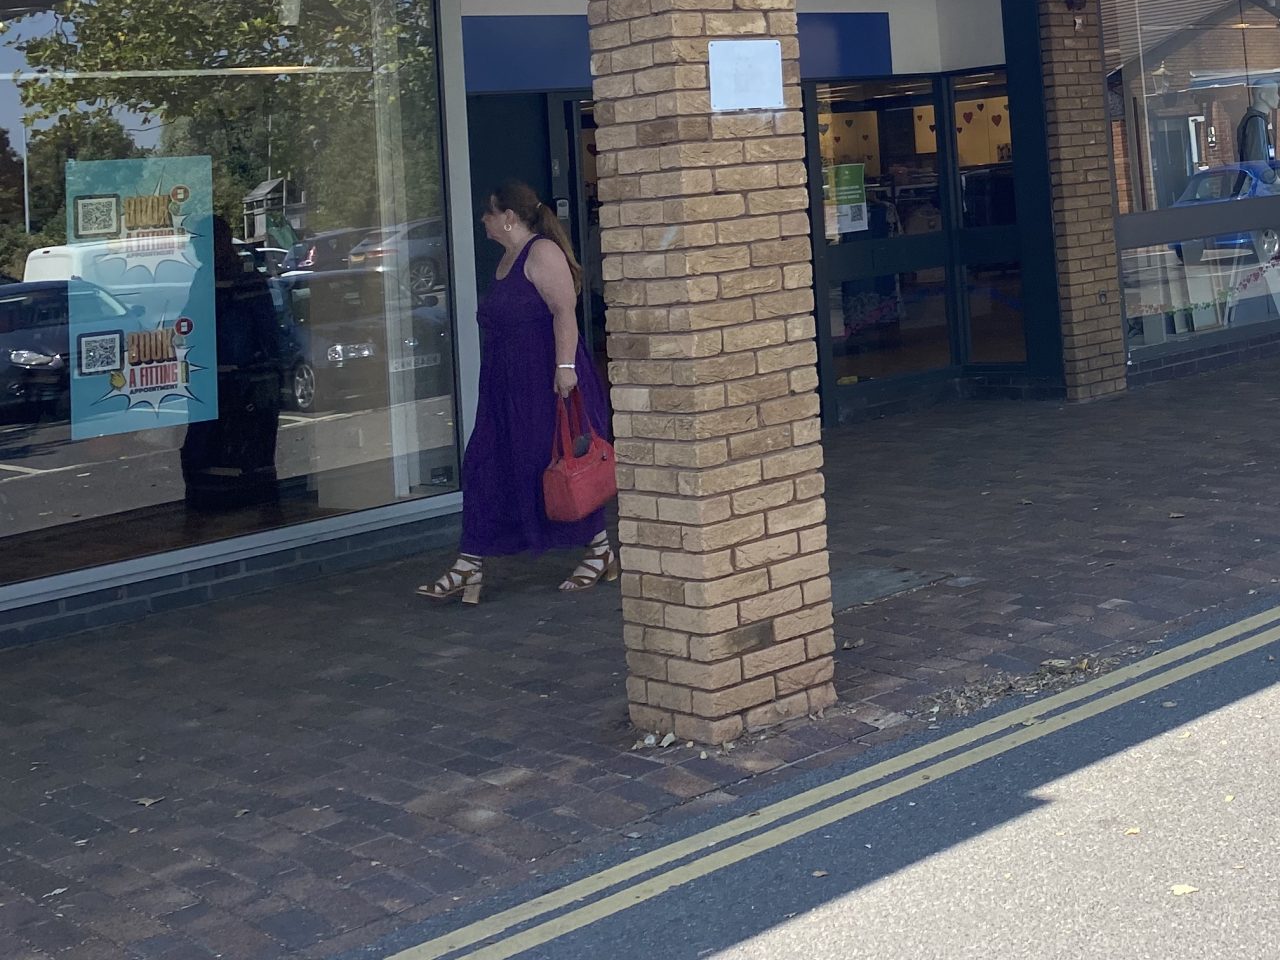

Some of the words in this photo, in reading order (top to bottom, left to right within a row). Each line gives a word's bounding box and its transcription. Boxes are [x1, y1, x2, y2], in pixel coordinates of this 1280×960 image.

[127, 328, 178, 366] BOOK
[129, 368, 136, 388] A
[140, 363, 178, 387] FITTING
